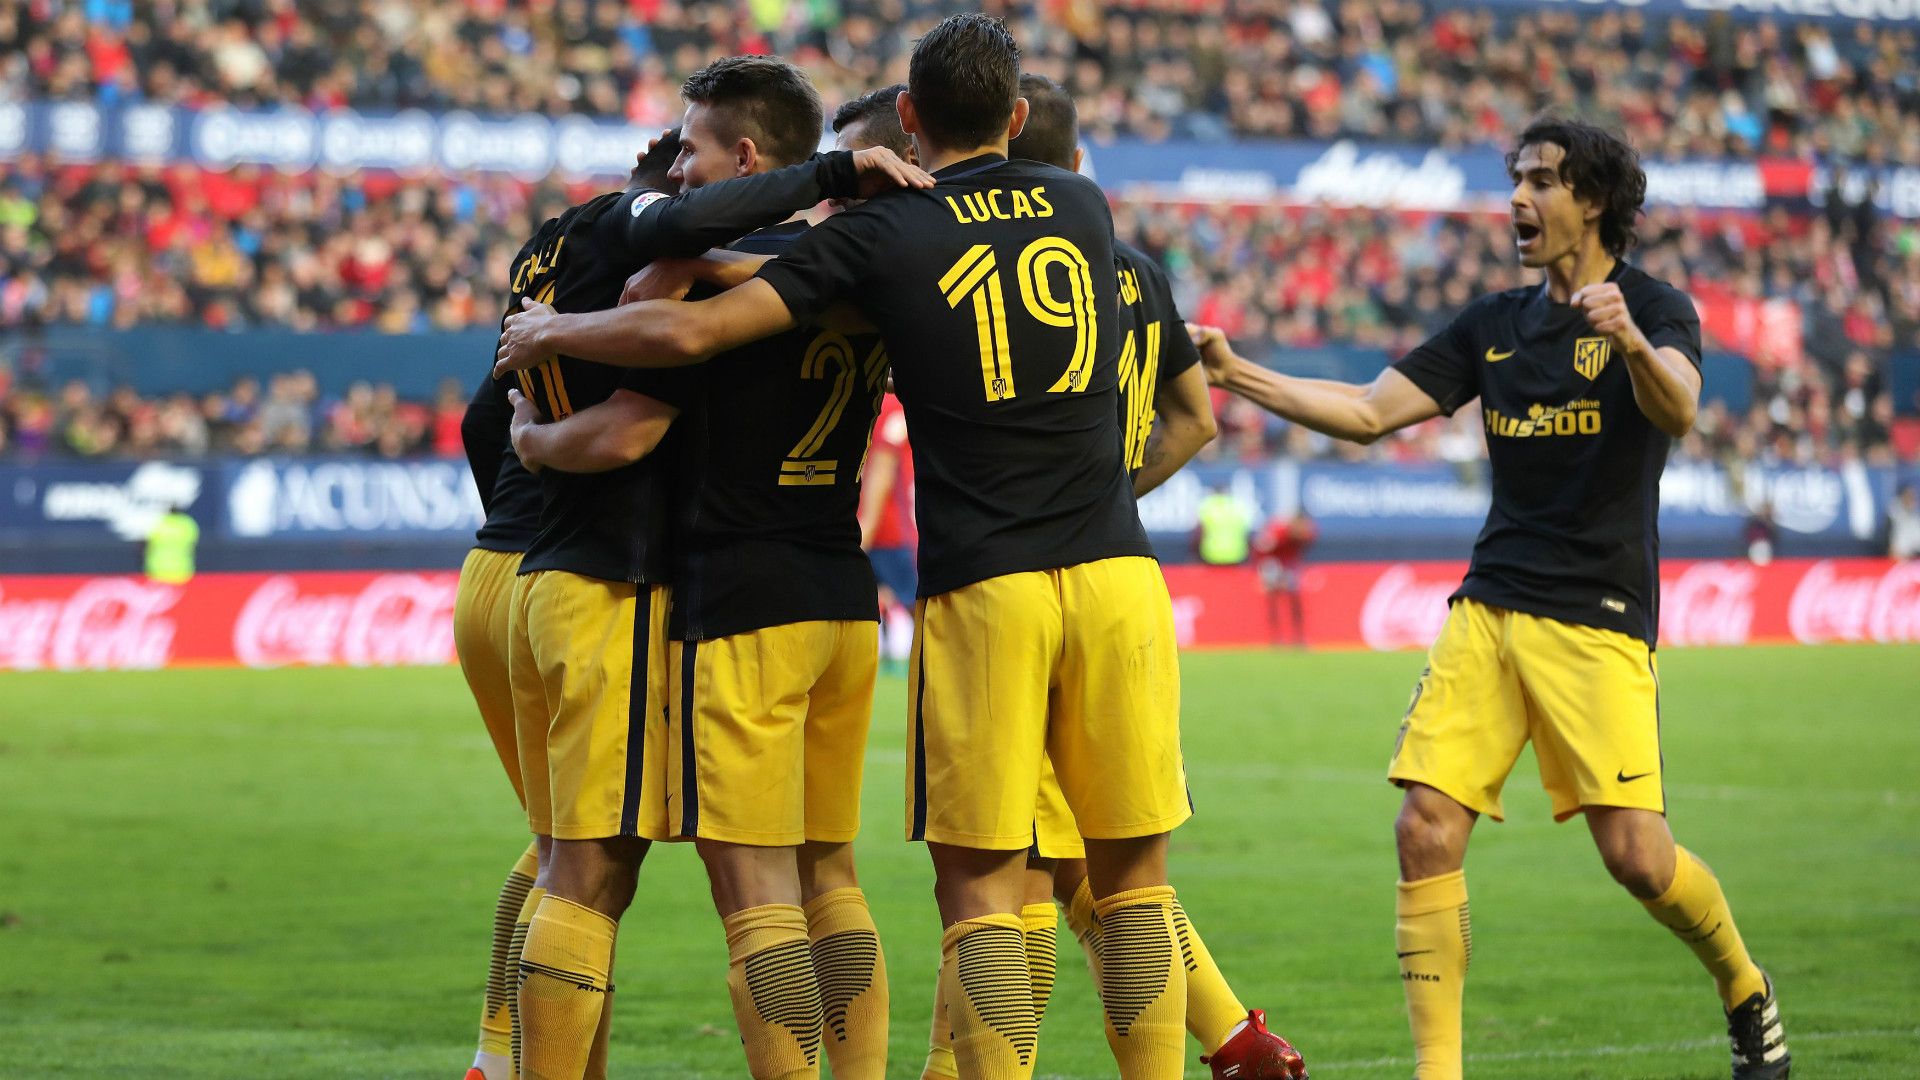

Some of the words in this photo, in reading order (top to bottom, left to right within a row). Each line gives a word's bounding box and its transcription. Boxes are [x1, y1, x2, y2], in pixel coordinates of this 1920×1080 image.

[945, 186, 1054, 223] LUCAS
[937, 236, 1098, 402] 19
[1118, 321, 1160, 475] 14
